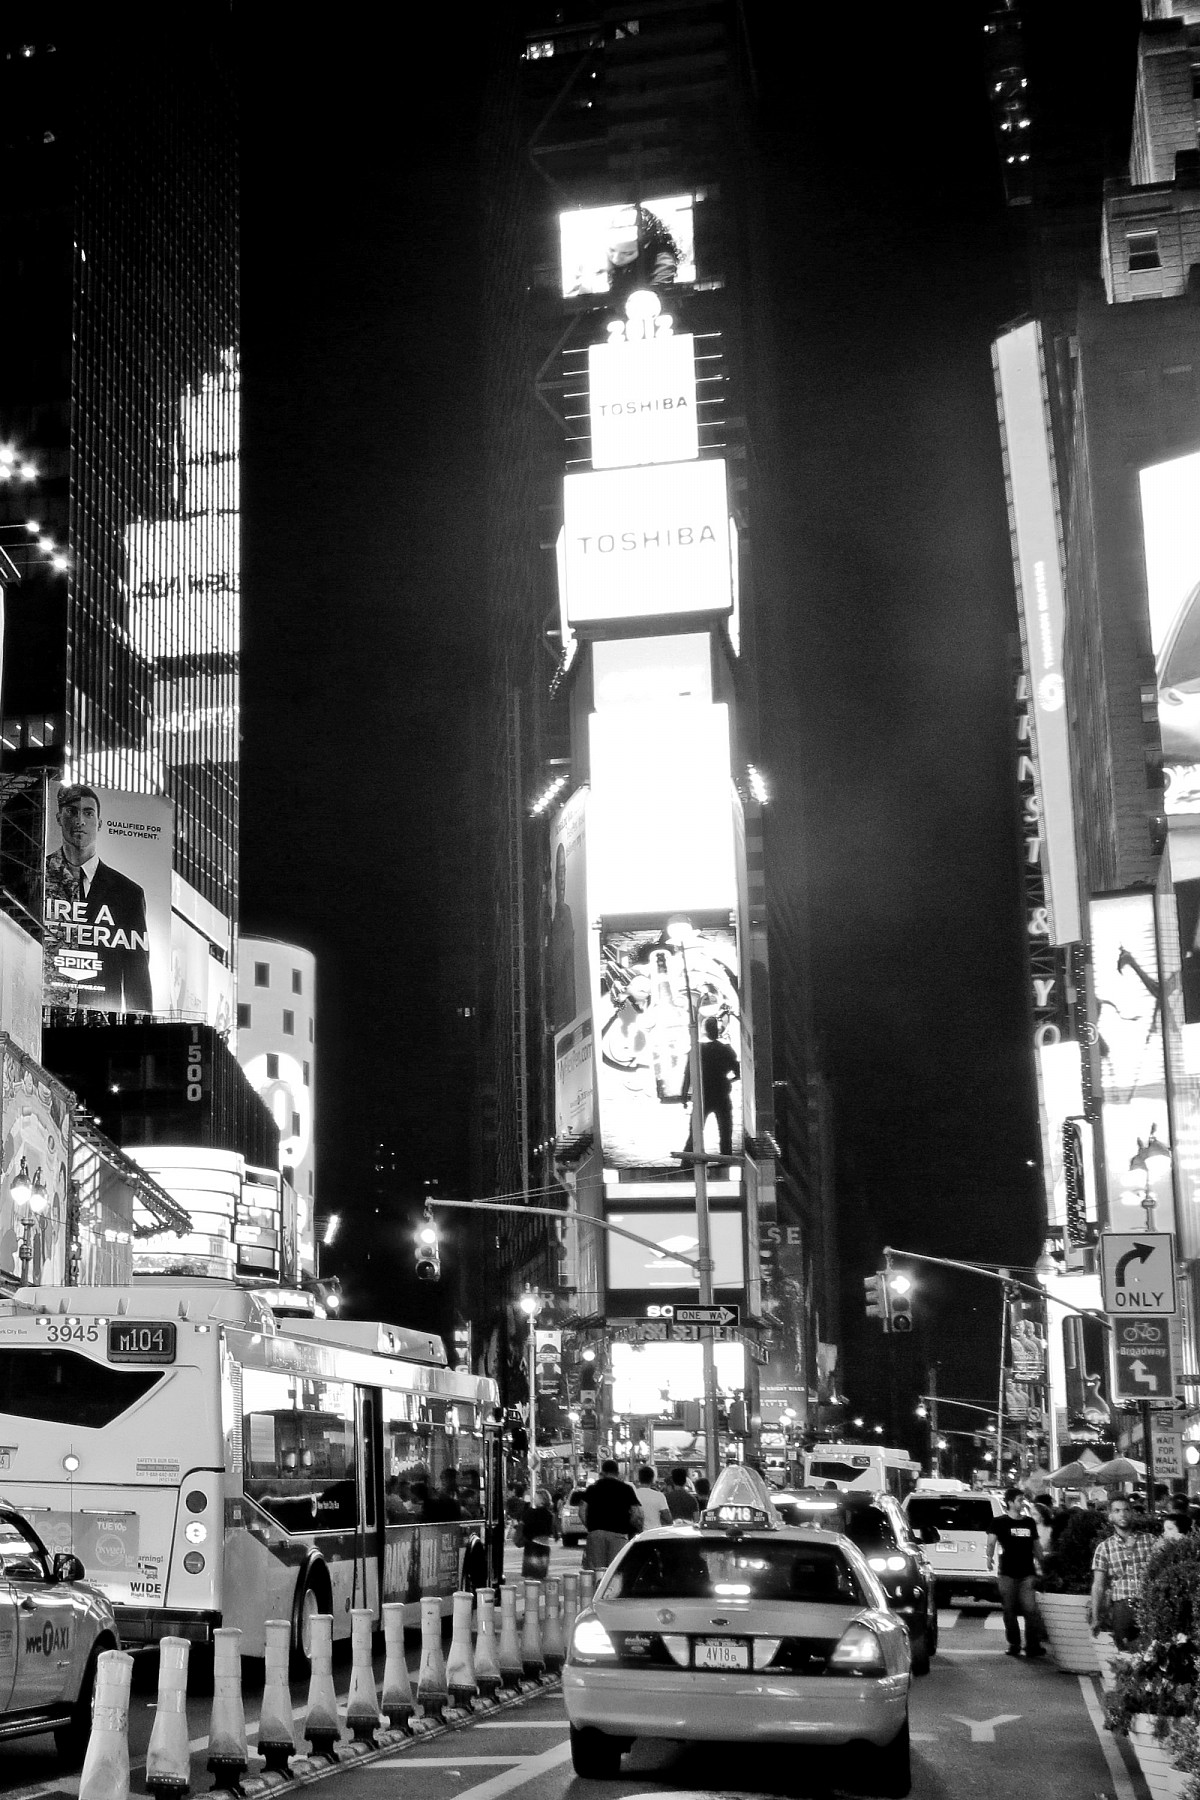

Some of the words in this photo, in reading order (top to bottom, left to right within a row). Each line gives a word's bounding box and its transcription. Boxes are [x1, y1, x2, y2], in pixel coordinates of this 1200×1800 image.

[599, 396, 688, 417] TOSHIBA
[578, 524, 716, 555] TOSHIBA
[106, 820, 145, 832] QUALIFIED
[147, 825, 162, 833] FOR
[108, 828, 160, 841] EMPLOYMENT.
[94, 904, 116, 927] A
[53, 956, 103, 971] SPIKE
[187, 1026, 202, 1102] 1500
[1115, 1292, 1164, 1308] ONLY
[682, 1311, 700, 1320] ONE
[709, 1311, 729, 1320] WAY
[47, 1325, 99, 1342] 3945
[119, 1328, 164, 1351] M104
[1120, 1347, 1167, 1357] Broadway
[1157, 1437, 1175, 1445] WAIT
[1158, 1447, 1174, 1455] FOR
[1155, 1457, 1178, 1465] WALK
[1155, 1467, 1180, 1475] SIGNAL
[719, 1506, 751, 1521] 4V18
[130, 1582, 162, 1594] WIDE
[25, 1636, 42, 1654] NYC
